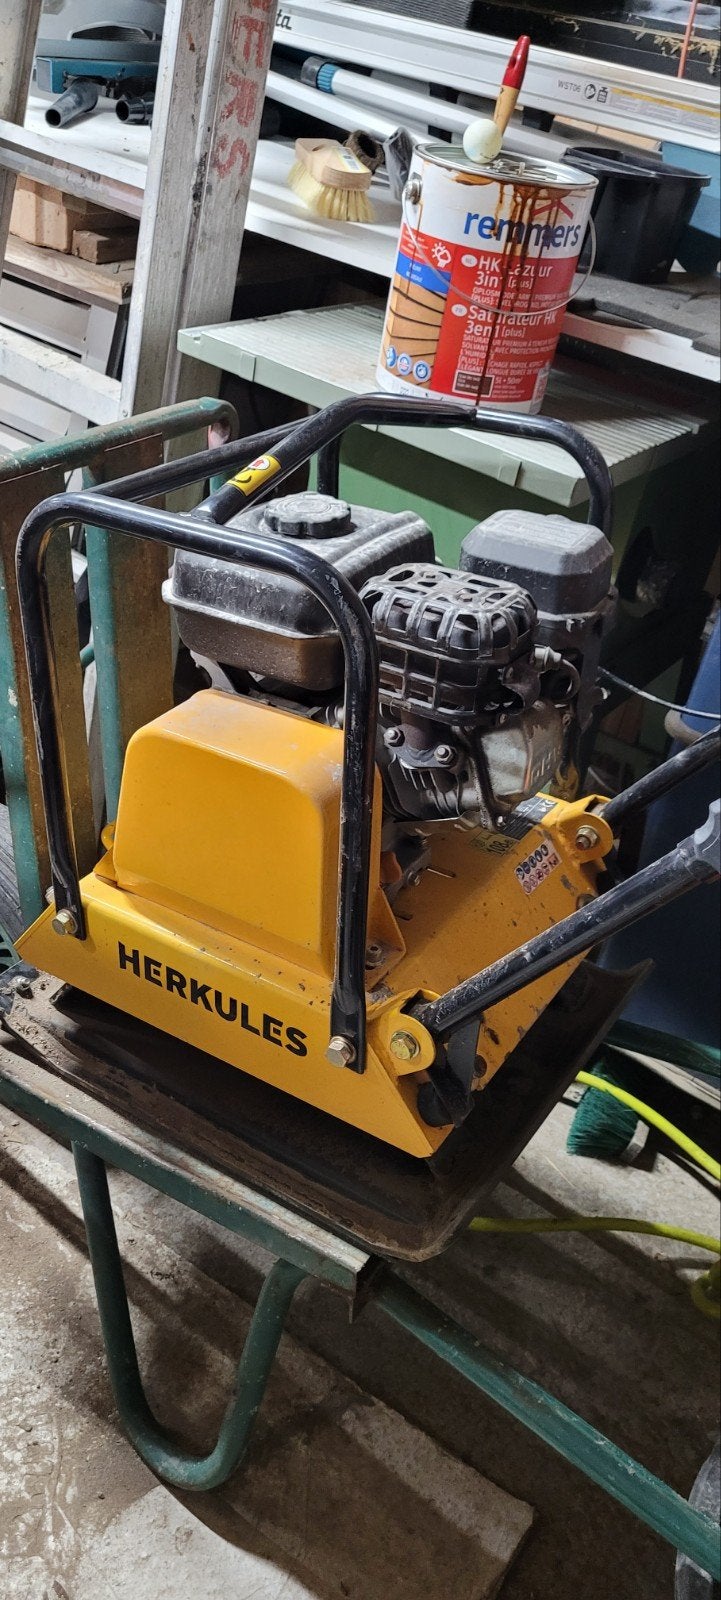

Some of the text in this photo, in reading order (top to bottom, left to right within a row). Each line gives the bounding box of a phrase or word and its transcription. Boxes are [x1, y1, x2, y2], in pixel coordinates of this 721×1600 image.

[275, 9, 292, 31] ta
[213, 0, 273, 179] ERS
[557, 79, 582, 93] WST06
[463, 212, 581, 248] remmers
[475, 271, 534, 290] 3in [pus]
[501, 325, 526, 338] [plus]
[118, 941, 308, 1057] HERKULES
